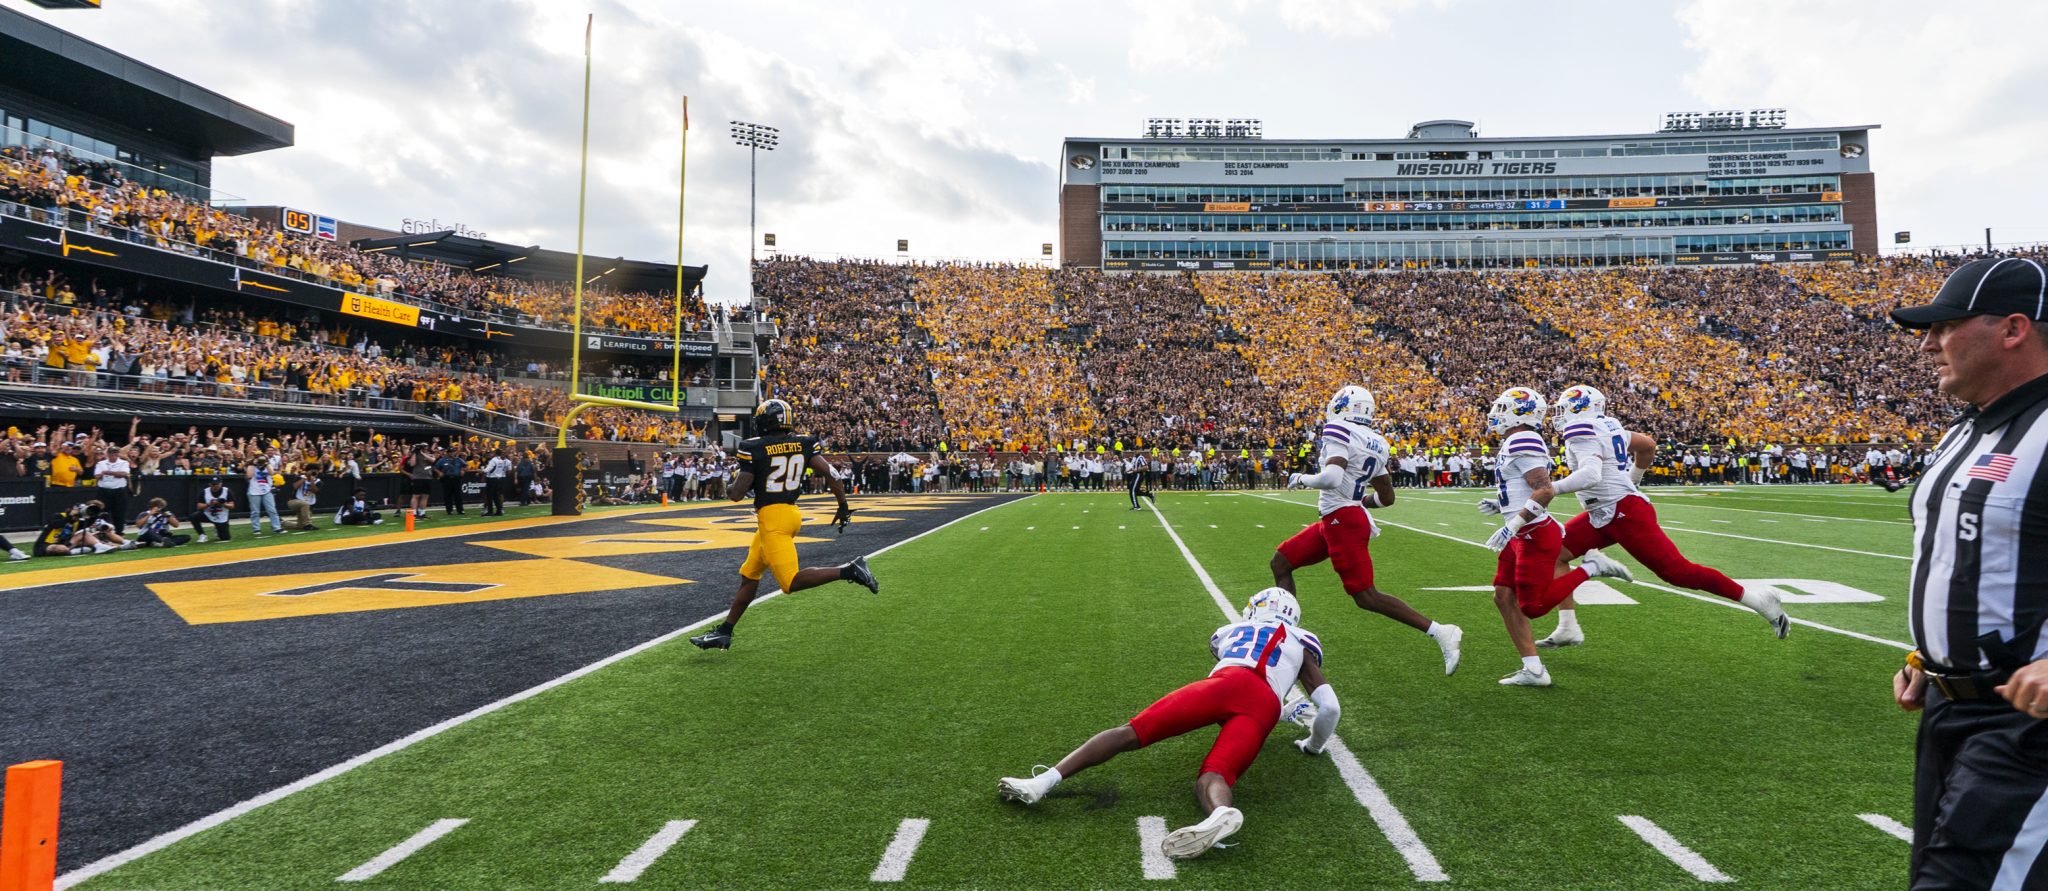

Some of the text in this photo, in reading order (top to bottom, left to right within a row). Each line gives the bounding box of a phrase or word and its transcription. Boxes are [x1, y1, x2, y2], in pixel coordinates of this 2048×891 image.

[1708, 153, 1748, 161] CONFERENCE
[1397, 162, 1557, 175] MISSOURI TIGERS
[1531, 201, 1540, 209] 31
[287, 211, 309, 230] 05
[363, 301, 411, 322] Health Care
[604, 341, 647, 350] LEARFIELD
[765, 442, 803, 456] ROBERTS
[766, 453, 805, 493] 20
[1352, 456, 1377, 501] 2
[1959, 512, 1979, 542] S
[1222, 626, 1282, 668] 26
